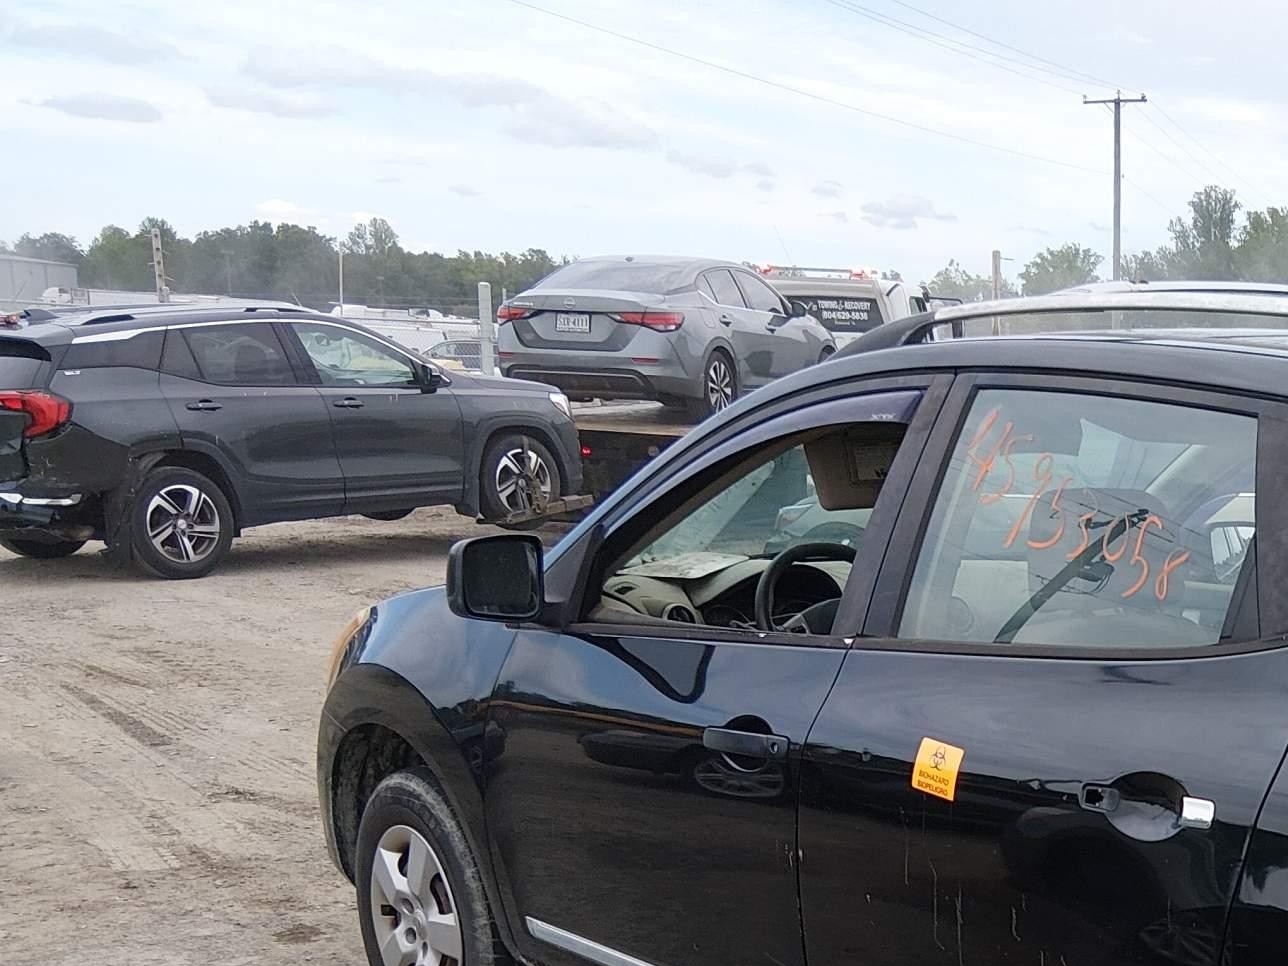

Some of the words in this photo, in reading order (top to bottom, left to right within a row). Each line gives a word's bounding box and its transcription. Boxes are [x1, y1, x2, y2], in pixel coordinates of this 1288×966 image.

[818, 300, 838, 310] TOWING
[845, 301, 871, 311] RECOVERY
[968, 406, 1190, 600] 45953058
[919, 769, 949, 787] BIOHAZARD
[917, 779, 948, 797] BIOPELIGRO
